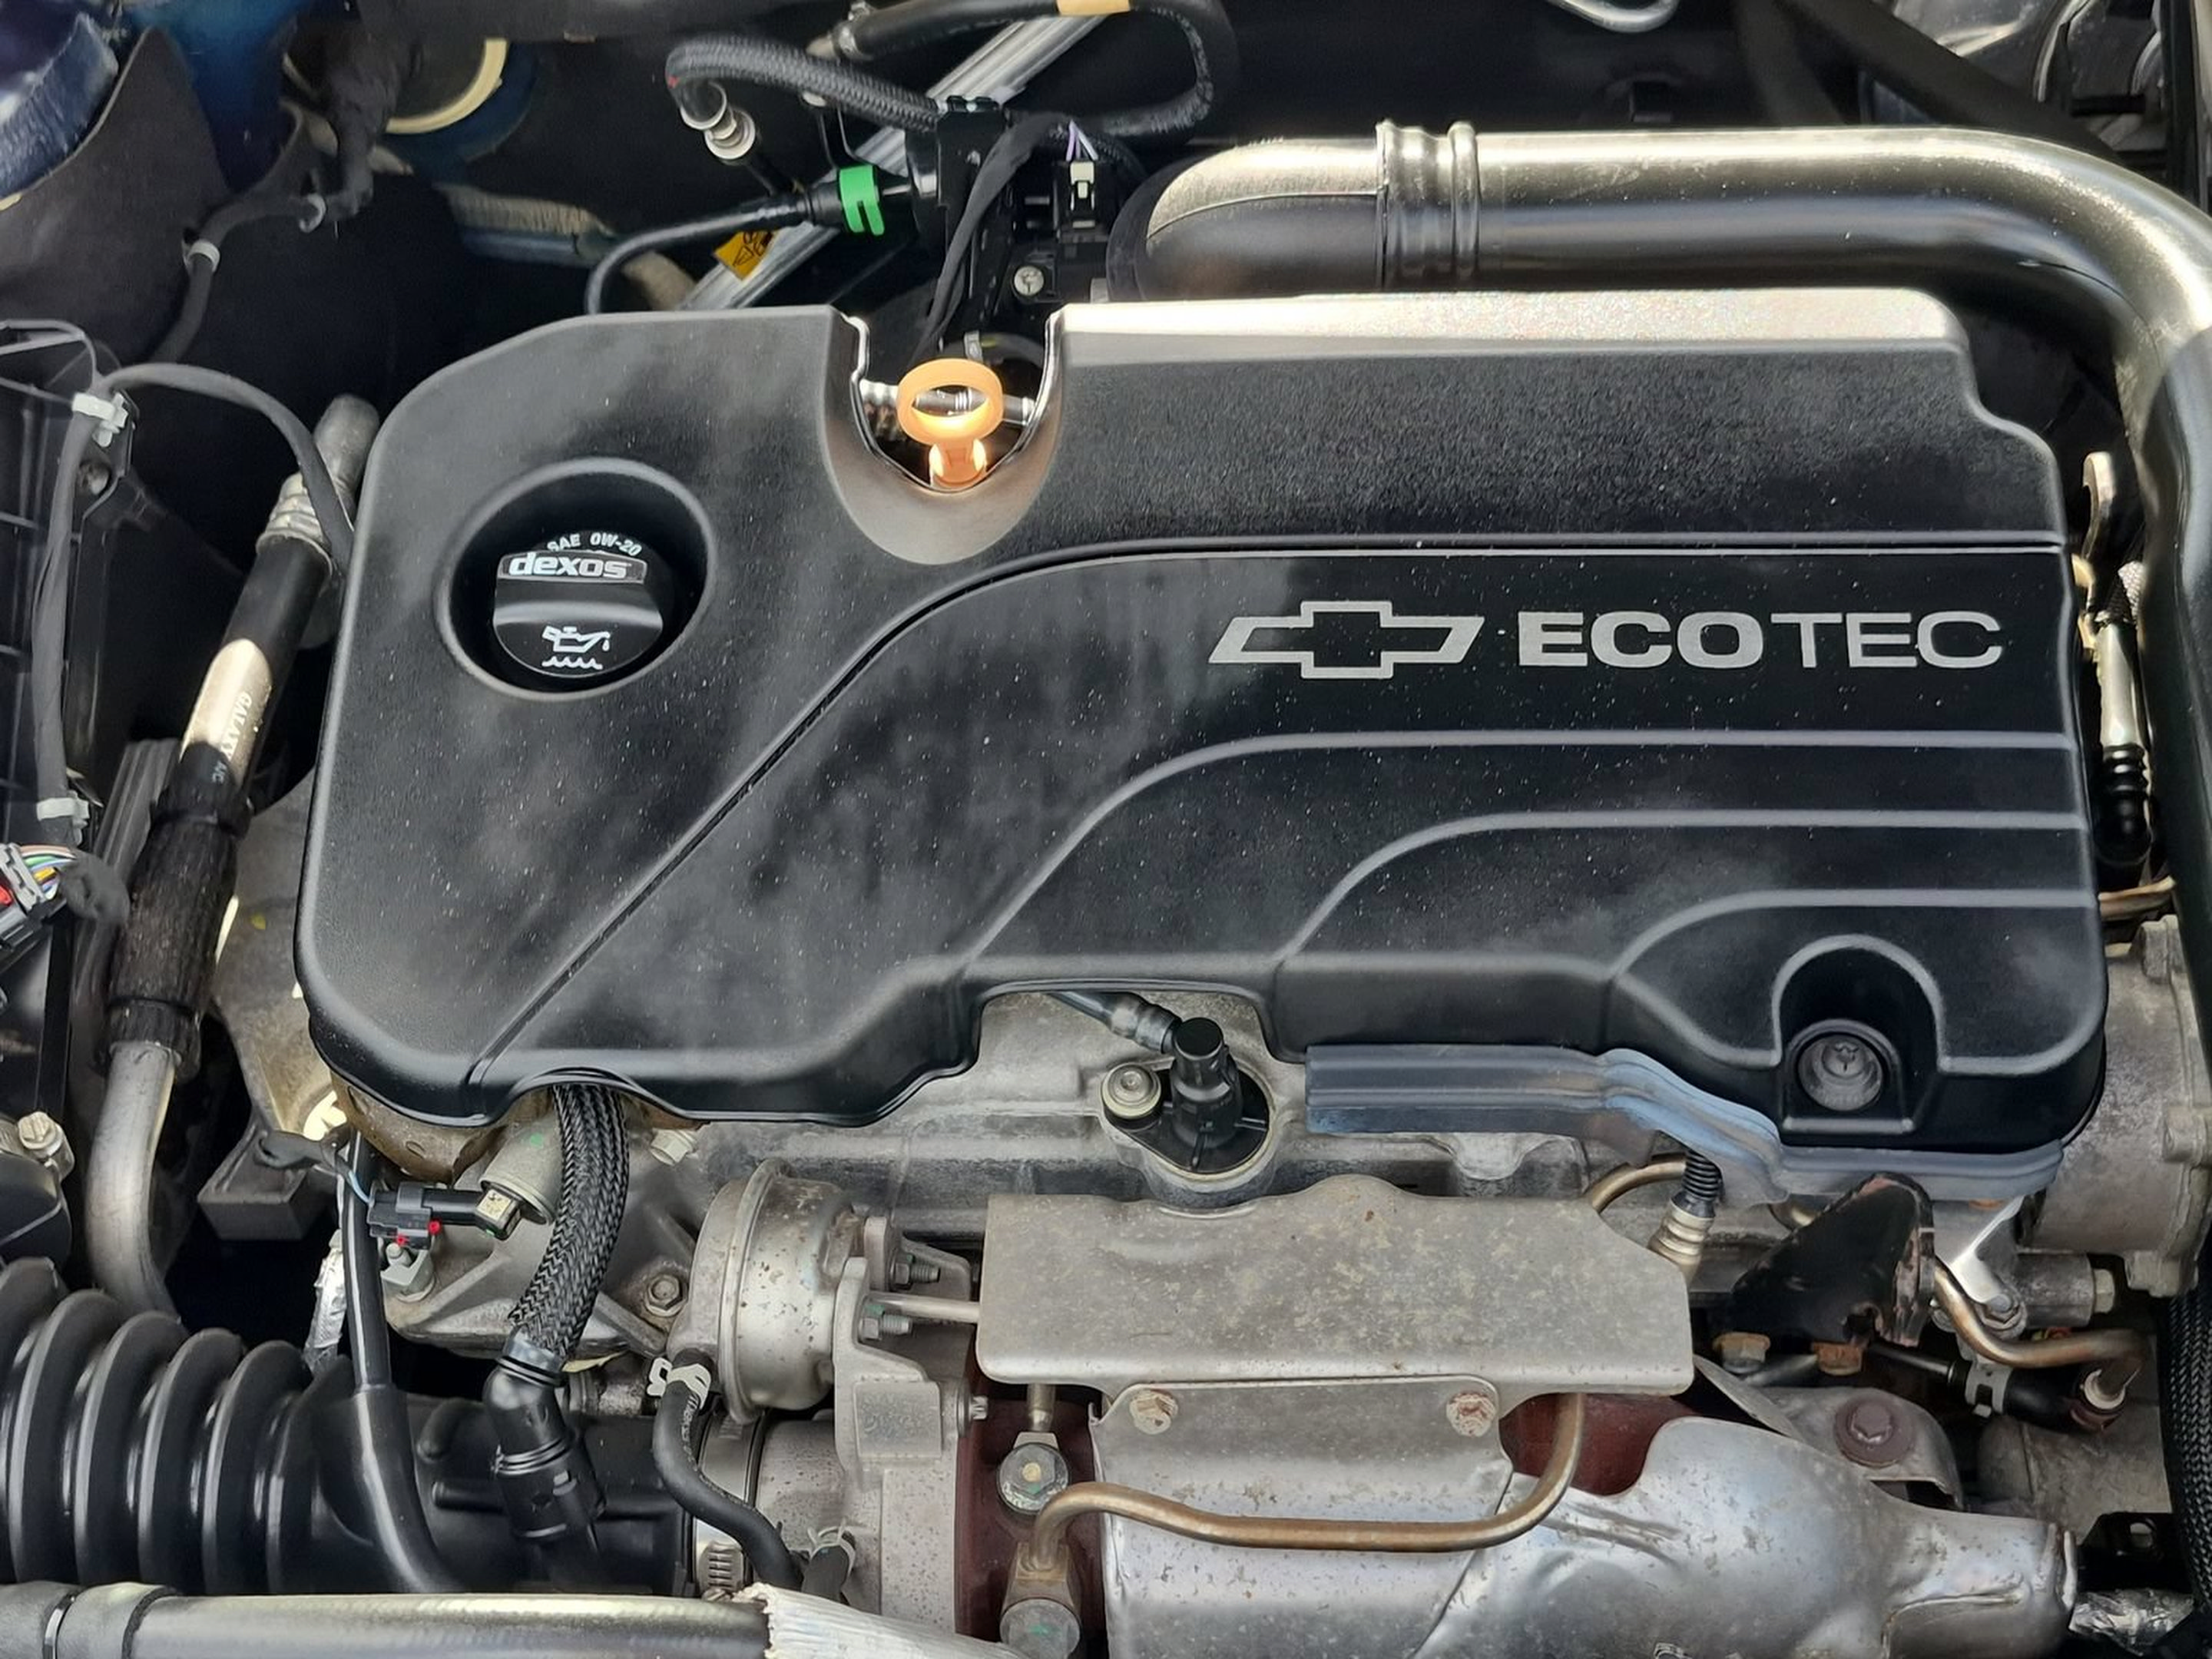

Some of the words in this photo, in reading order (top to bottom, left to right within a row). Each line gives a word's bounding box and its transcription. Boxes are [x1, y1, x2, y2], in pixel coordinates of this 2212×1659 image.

[547, 533, 581, 552] SAE
[590, 531, 642, 556] 0W-20
[508, 551, 627, 578] dexos
[1517, 611, 2003, 670] ECOTEC
